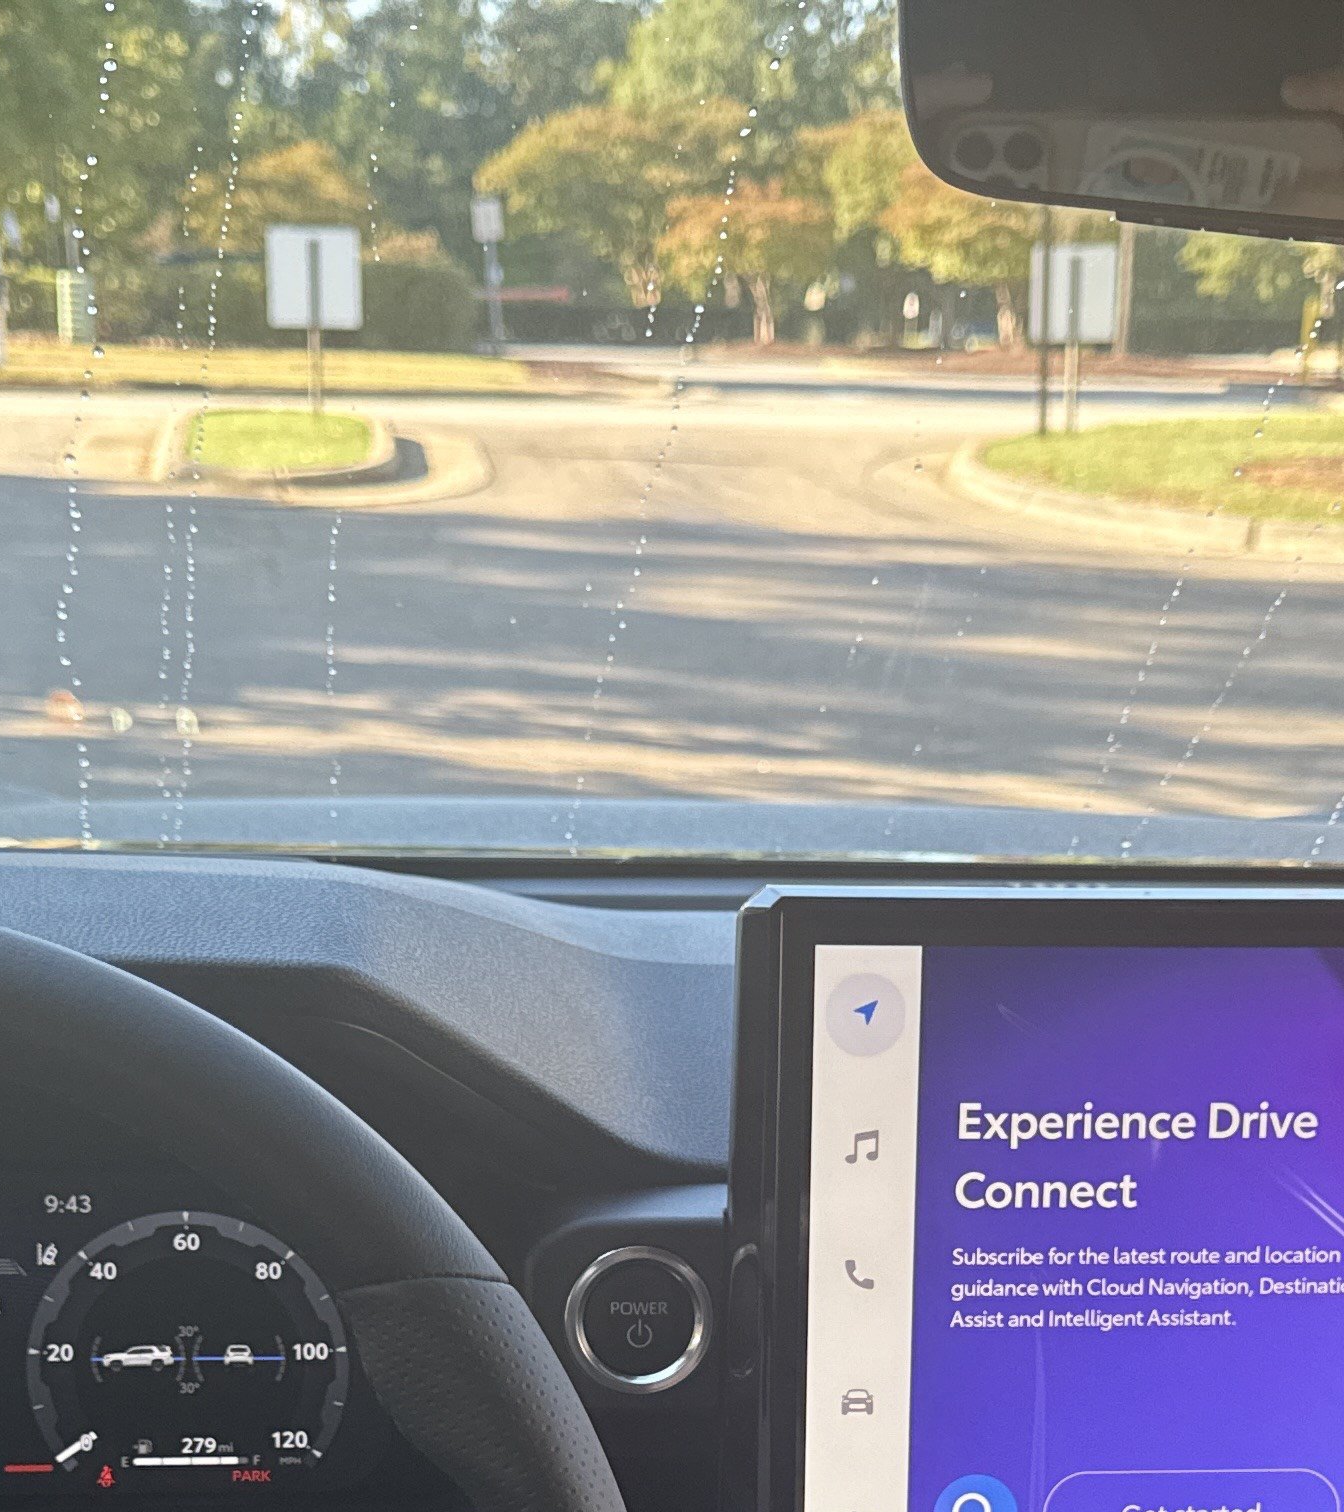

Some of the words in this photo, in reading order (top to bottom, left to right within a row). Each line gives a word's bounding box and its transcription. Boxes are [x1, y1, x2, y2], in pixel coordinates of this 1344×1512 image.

[958, 1101, 1197, 1150] Experience
[1208, 1101, 1319, 1139] Drive
[955, 1171, 1137, 1209] Connect
[44, 1194, 92, 1214] 9:43
[172, 1232, 201, 1253] 60
[952, 1247, 1044, 1266] Subscribe
[1048, 1247, 1076, 1265] for
[1078, 1247, 1110, 1265] the
[1113, 1246, 1166, 1265] latest
[1170, 1248, 1220, 1264] route
[1224, 1245, 1260, 1264] and
[1265, 1245, 1341, 1263] location
[88, 1262, 117, 1282] 40
[255, 1262, 283, 1281] 80
[951, 1278, 1039, 1301] guidance
[1042, 1278, 1083, 1296] with
[1086, 1278, 1144, 1296] Cloud
[1148, 1277, 1254, 1300] Navigation,
[610, 1301, 669, 1315] POWER
[950, 1310, 1004, 1328] Assist
[1008, 1309, 1044, 1328] and
[1048, 1309, 1144, 1331] Intelligent
[1147, 1309, 1237, 1327] Assistant.
[45, 1344, 74, 1364] 20
[292, 1343, 330, 1362] 100
[181, 1437, 217, 1454] 279
[271, 1430, 308, 1449] 120
[121, 1457, 129, 1468] E
[253, 1455, 260, 1466] F
[279, 1456, 302, 1465] MPH
[232, 1470, 272, 1482] PARK
